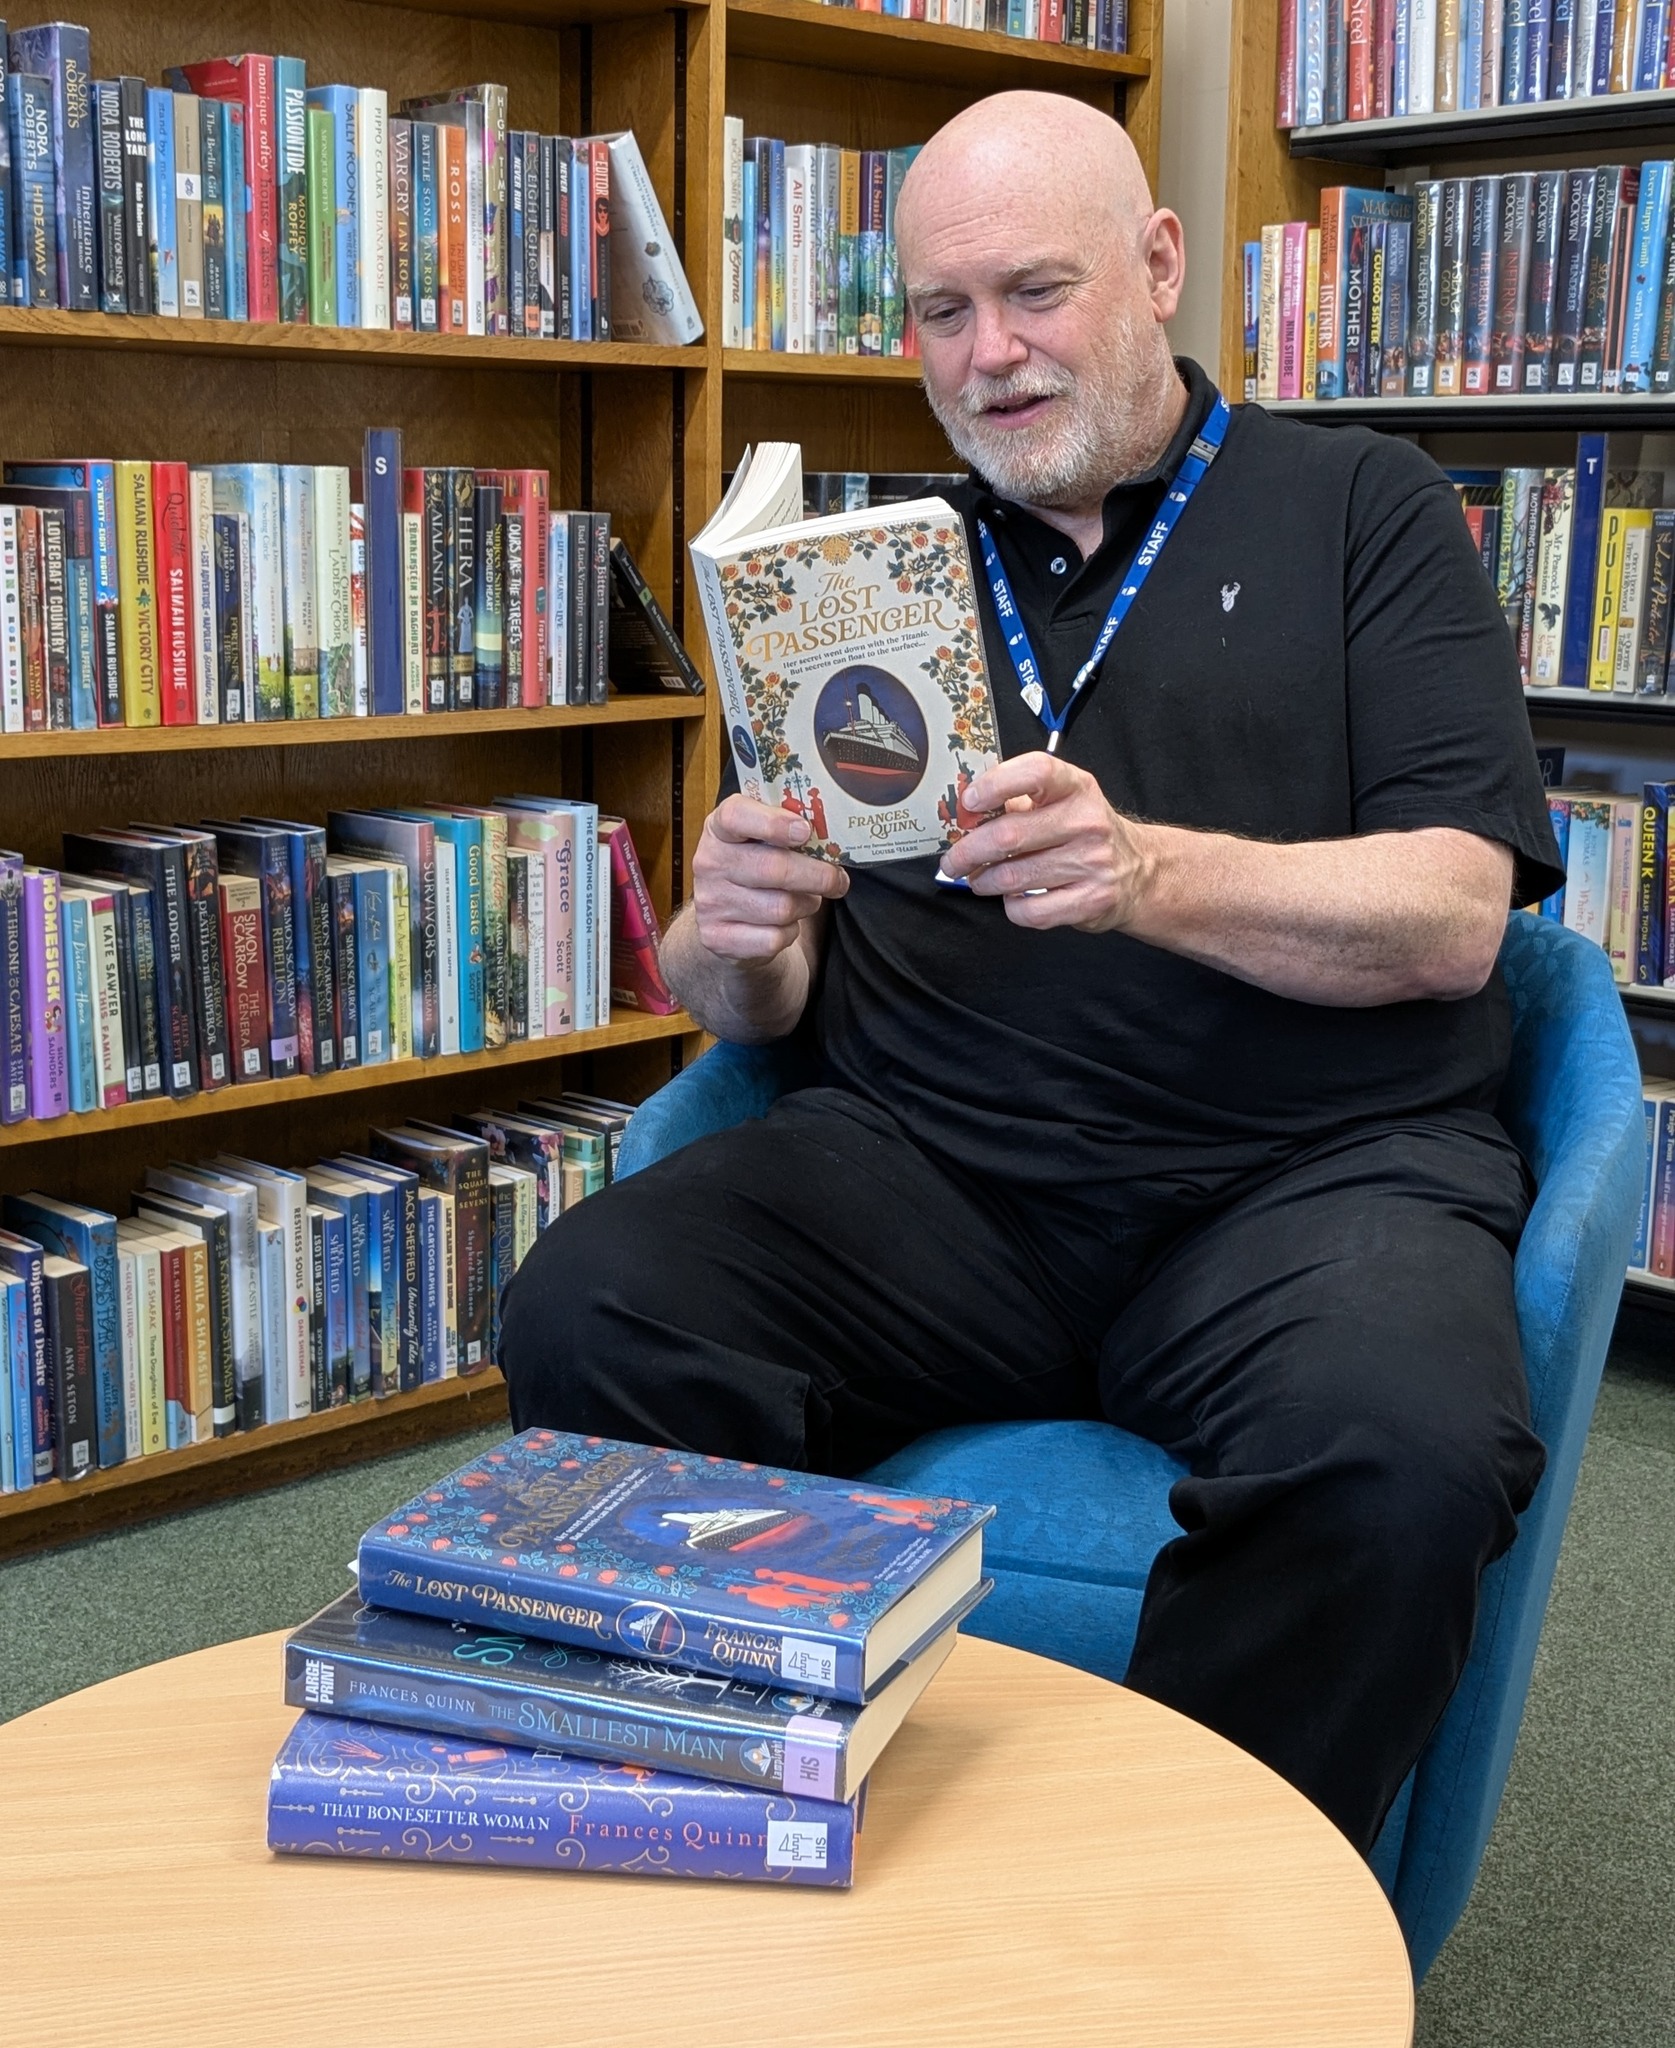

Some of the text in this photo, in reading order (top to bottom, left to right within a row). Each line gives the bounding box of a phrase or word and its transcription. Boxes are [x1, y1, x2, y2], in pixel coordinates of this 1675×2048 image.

[65, 58, 79, 128] ROBERTS
[78, 72, 88, 118] NORA
[129, 117, 144, 128] THE
[25, 93, 37, 170] ROBERTS
[36, 109, 48, 157] NORA
[101, 90, 121, 189] NORA ROBERTS
[126, 130, 146, 142] LONG
[126, 144, 147, 156] TAKE
[207, 111, 217, 198] The Berlin Girl
[285, 88, 305, 175] PASSIONTIDE
[345, 103, 356, 218] SALLY ROONEY
[422, 134, 430, 181] BATTLE
[451, 166, 460, 224] ROSS
[595, 160, 608, 195] EDITOR
[1594, 176, 1607, 238] STOCKWIN
[33, 184, 46, 275] HIDEAWAY
[82, 186, 93, 273] Inheritance
[288, 202, 298, 254] ROFFEY
[298, 194, 306, 263] MONIQUE
[1443, 187, 1455, 246] STOCKWIN
[1504, 184, 1515, 243] STOCKWIN
[1536, 182, 1549, 243] STOCKWIN
[1568, 180, 1582, 241] STOCKWIN
[1637, 170, 1657, 268] Every Happy Family
[1347, 269, 1361, 346] MOTHER
[1372, 254, 1382, 303] CUCKOO
[1284, 320, 1295, 377] NINA STIBBE
[1371, 306, 1380, 343] SISTER
[1630, 291, 1645, 358] sarah stovell
[375, 456, 388, 475] S
[1586, 457, 1598, 474] T
[133, 474, 149, 585] SALMAN RUSHDIE
[432, 508, 443, 594] ATALANTA
[459, 516, 472, 588] HERA
[1137, 520, 1169, 567] STAFF
[1525, 492, 1538, 584] MOTHERING SUNDAY
[47, 521, 65, 653] LOVECRAFT COUNTRY
[507, 524, 522, 644] OURS ARE THE STREETS
[597, 523, 607, 606] Twice Bitten
[814, 570, 855, 598] The
[170, 569, 187, 690] SALMAN RUSHDIE
[799, 584, 881, 625] LOST
[993, 579, 1014, 617] STAFF
[105, 613, 118, 699] SALMAN RUSHDIE
[138, 610, 154, 696] VICTORY CITY
[745, 598, 960, 663] PASSENGER
[783, 630, 930, 669] Her secret went down with the Titanic.
[790, 666, 804, 676] But
[805, 660, 831, 672] secrets
[832, 656, 847, 665] can
[848, 652, 865, 663] float
[877, 647, 890, 656] the
[1019, 659, 1035, 684] STA
[848, 809, 910, 829] FRANCES
[869, 817, 926, 840] QUINN
[1641, 807, 1656, 878] QUEEN K
[469, 845, 480, 936] Good Taste
[556, 839, 572, 913] Grace
[585, 838, 594, 891] GROWING
[42, 876, 61, 1003] HOMESICK
[165, 865, 181, 963] THE LODGER
[243, 914, 258, 964] SIMON
[103, 925, 119, 1017] KATE SAWYER
[208, 914, 223, 1029] SIMON SCARROW
[233, 916, 247, 989] SCARROW
[272, 927, 286, 1004] REBELLION
[284, 906, 296, 1018] SIMON SCARROW
[321, 903, 333, 1014] SIMON SCARROW
[249, 991, 260, 1017] THE
[465, 1170, 482, 1178] THE
[294, 1207, 303, 1289] RESTLESS SOULS
[406, 1189, 416, 1282] JACK SHEFFIELD
[314, 1234, 323, 1305] HOPE NOT LOST
[30, 1259, 46, 1386] Objects of Desire
[193, 1250, 209, 1387] KAMILA SHAMSIE
[219, 1259, 234, 1404] KAMILA SHAMSIE
[65, 1347, 76, 1424] ANYA SETON
[385, 1569, 612, 1641] The LOST PASSENGER
[305, 1658, 320, 1703] LARGE
[320, 1662, 334, 1705] PRINT
[711, 1641, 779, 1675] QUINN
[821, 1658, 831, 1680] HIS
[349, 1681, 476, 1713] FRANCES QUINN
[488, 1702, 726, 1761] THE SMALLEST MAN
[799, 1755, 820, 1783] HIS
[320, 1802, 551, 1830] THAT BONESETTER WOMAN
[568, 1814, 673, 1841] Frances
[815, 1837, 827, 1861] HIS
